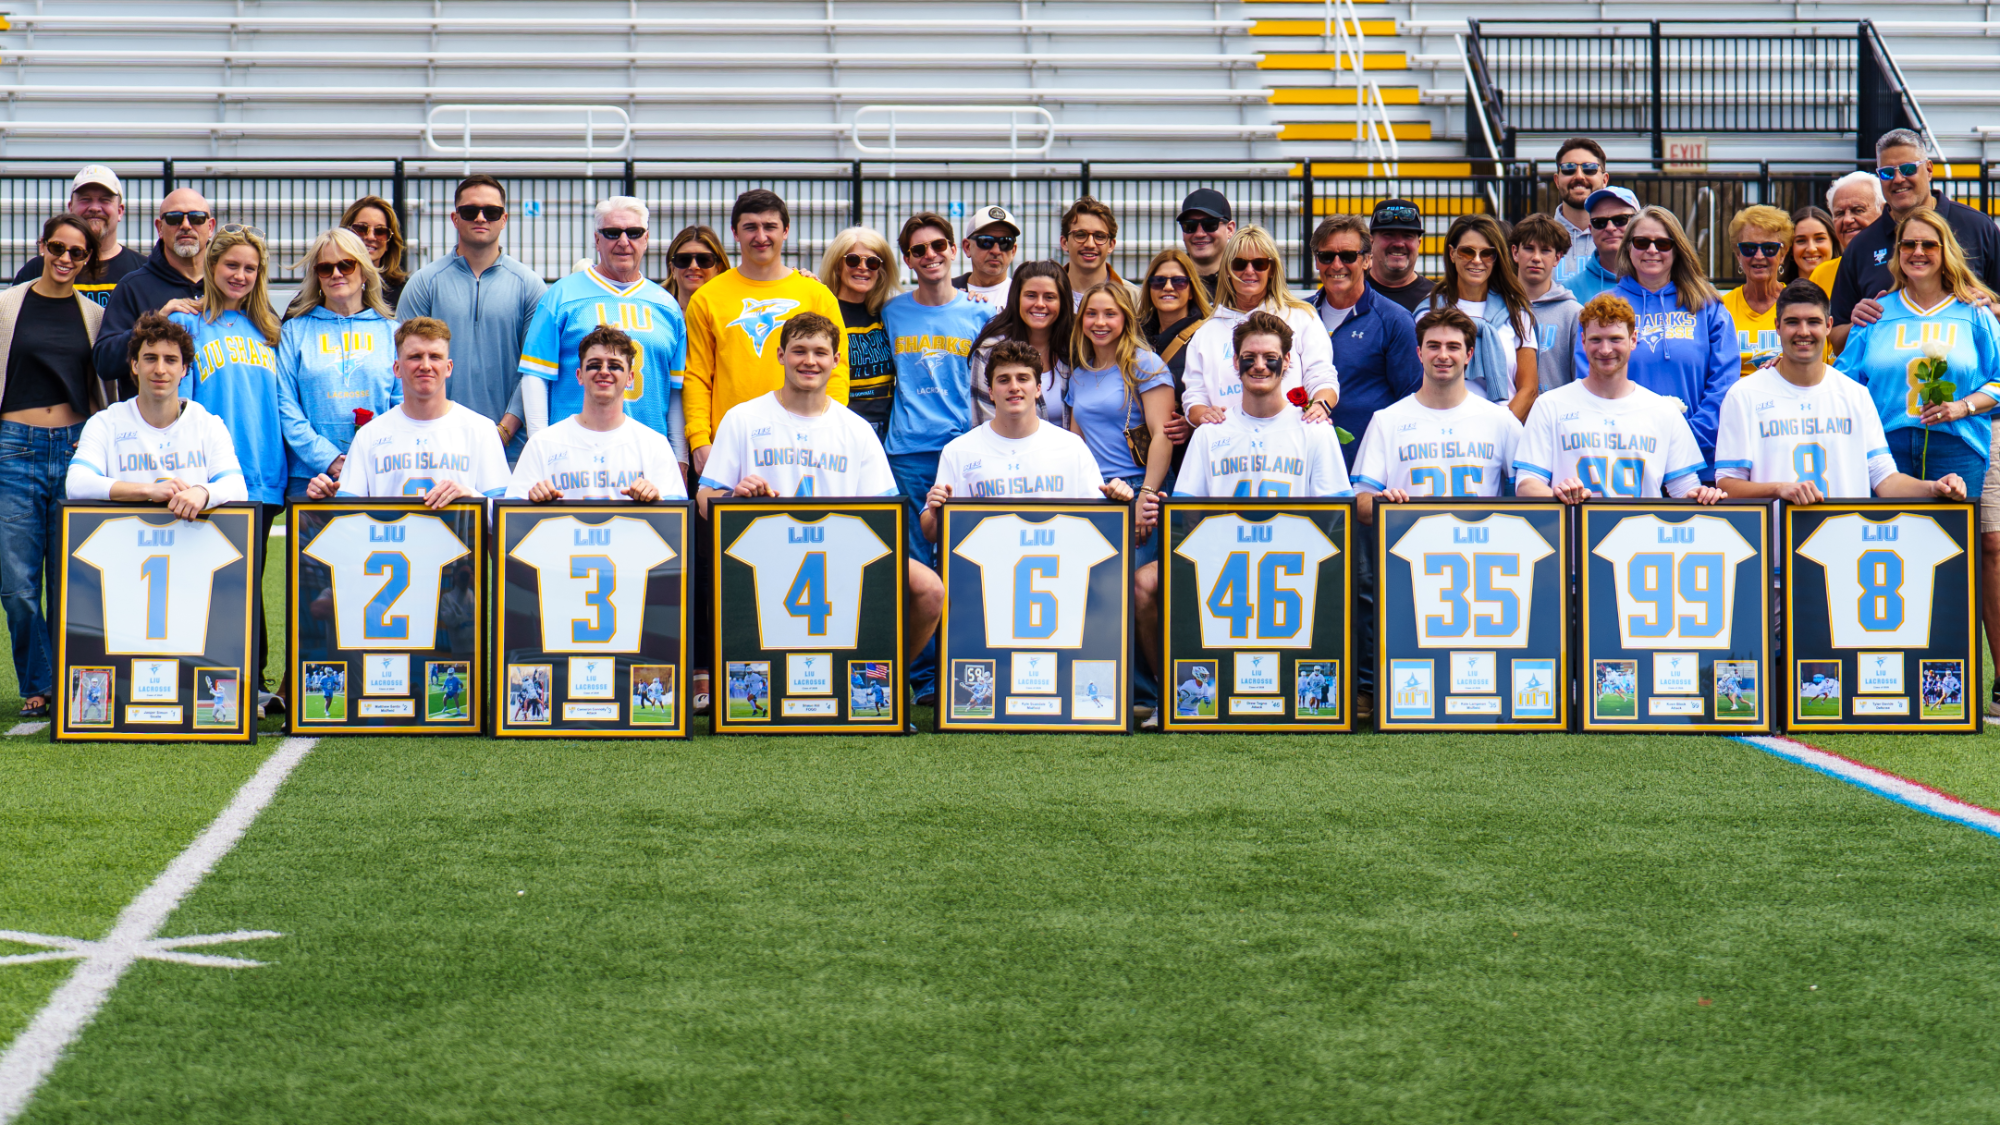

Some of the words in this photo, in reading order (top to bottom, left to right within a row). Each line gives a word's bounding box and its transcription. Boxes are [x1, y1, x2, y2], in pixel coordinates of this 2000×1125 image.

[1670, 144, 1702, 167] EXIT
[595, 302, 654, 333] LIU
[319, 331, 374, 355] LIU
[895, 334, 972, 358] SHARKS
[1894, 322, 1958, 350] LIU
[194, 338, 226, 384] LIU
[327, 389, 370, 399] LACROSSE
[1759, 419, 1799, 438] LONG
[1801, 417, 1852, 436] ISLAND
[1399, 442, 1438, 462] LONG
[1441, 441, 1495, 461] ISLAND
[1561, 432, 1600, 452] LONG
[1603, 433, 1657, 454] ISLAND
[118, 452, 157, 472] LONG
[375, 452, 411, 474] LONG
[415, 452, 470, 473] ISLAND
[752, 447, 796, 468] LONG
[797, 447, 848, 473] ISLAND
[1211, 455, 1248, 477] LONG
[1250, 454, 1305, 476] ISLAND
[1792, 441, 1829, 497] 8
[551, 471, 590, 491] LONG
[968, 479, 1005, 498] LONG
[1009, 475, 1064, 495] ISLAND
[138, 529, 175, 547] LIU
[369, 524, 406, 543] LIU
[574, 528, 611, 547] LIU
[788, 526, 824, 544] LIU
[1019, 529, 1055, 547] LIU
[1236, 524, 1273, 543] LIU
[1453, 526, 1489, 544] LIU
[1657, 526, 1695, 544] LIU
[1861, 524, 1899, 542] LIU
[141, 554, 170, 640] 1
[363, 551, 410, 640] 2
[570, 554, 617, 643] 3
[782, 551, 832, 636] 4
[1012, 554, 1060, 640] 6
[1205, 551, 1305, 640] 46
[1423, 552, 1520, 638] 35
[1627, 552, 1725, 638] 99
[1857, 549, 1904, 632] 8
